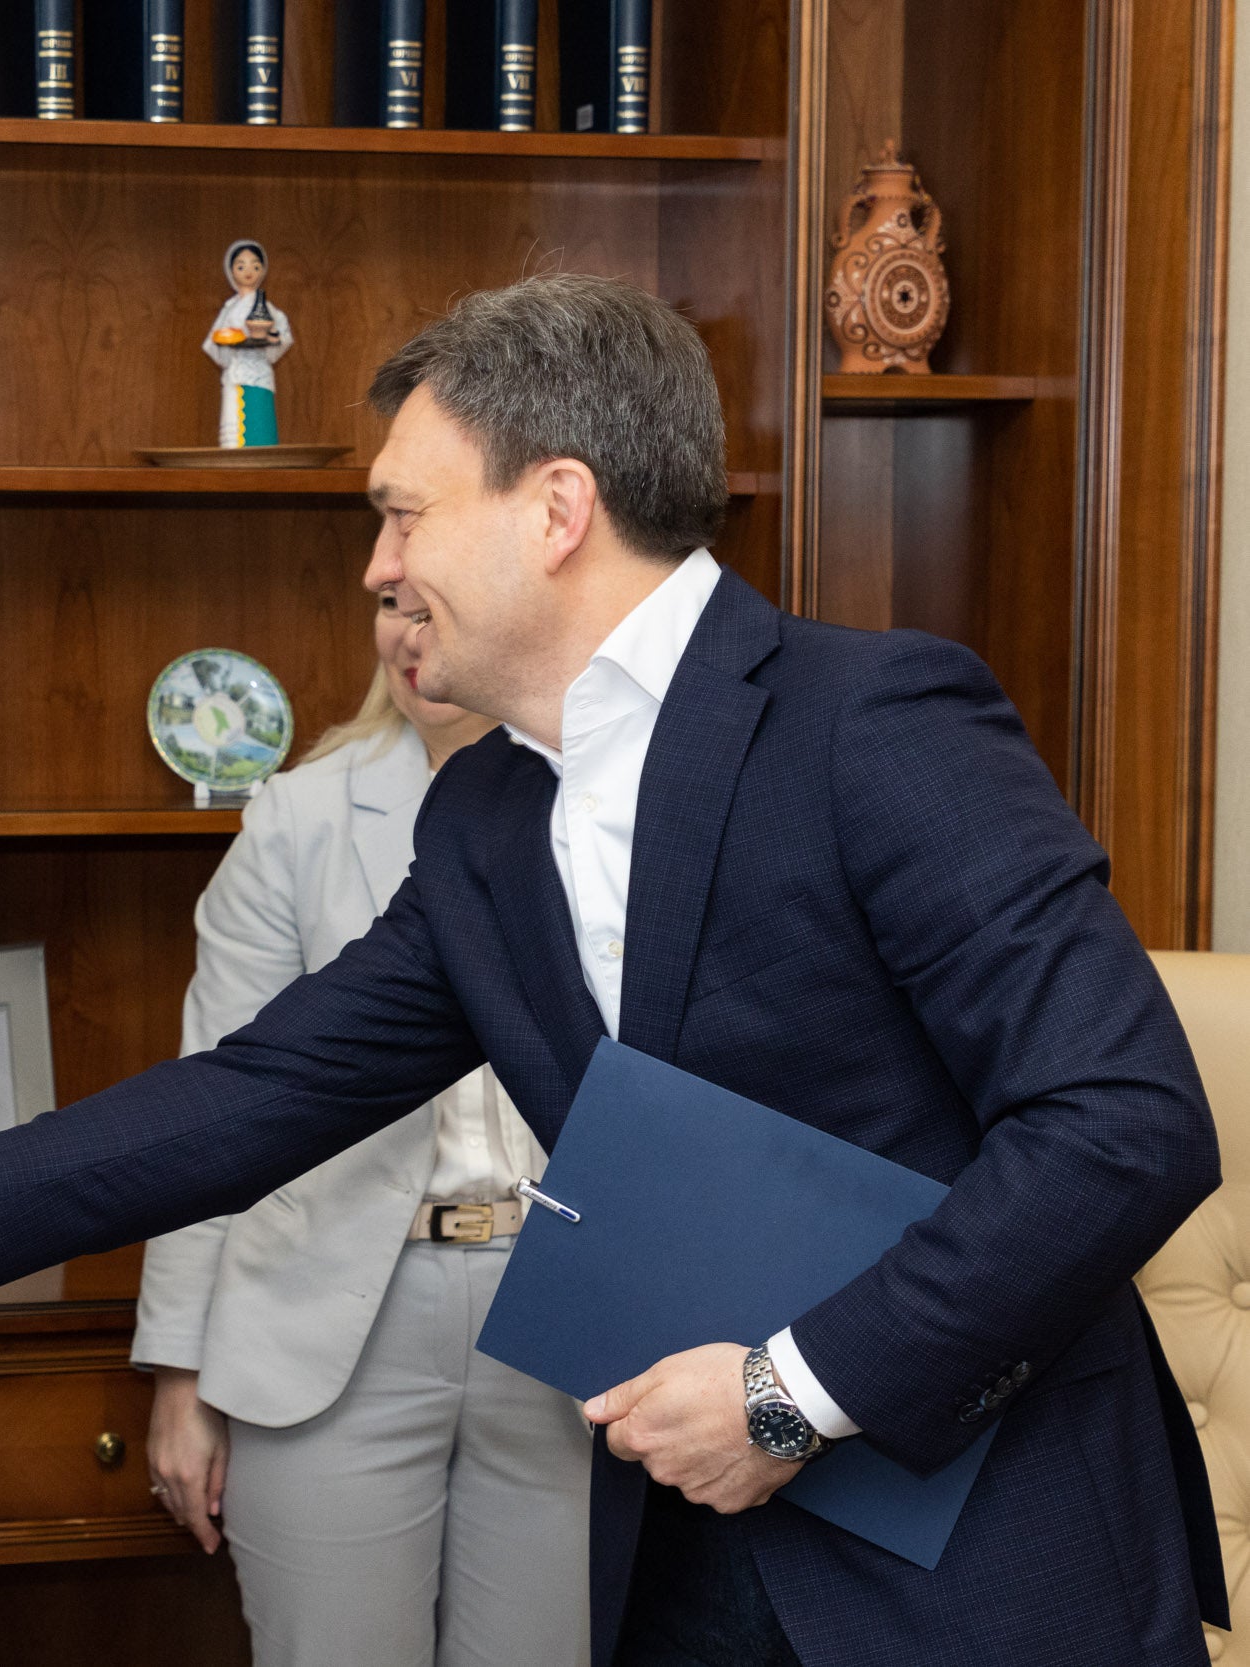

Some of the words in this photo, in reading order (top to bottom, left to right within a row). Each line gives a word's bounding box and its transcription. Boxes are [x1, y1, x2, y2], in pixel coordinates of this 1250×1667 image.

[49, 63, 67, 80] III
[165, 64, 180, 80] IV
[257, 67, 271, 84] V
[400, 70, 417, 87] VI
